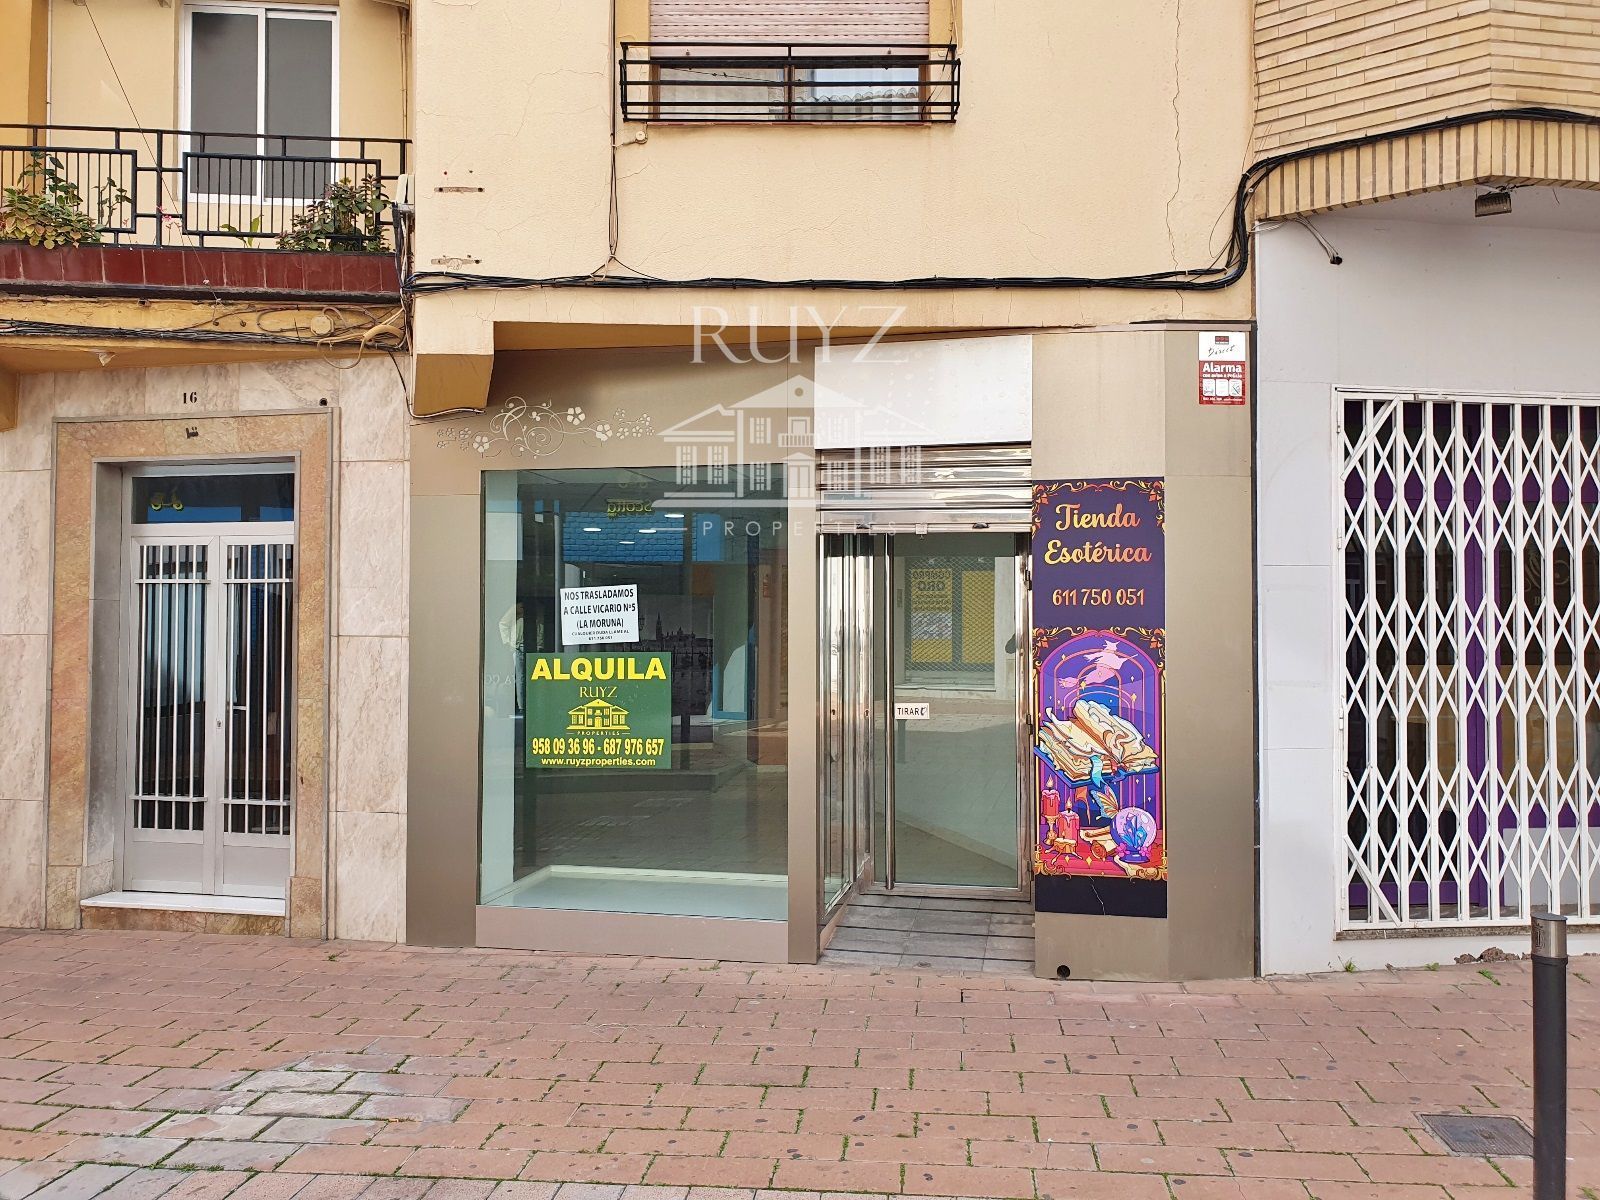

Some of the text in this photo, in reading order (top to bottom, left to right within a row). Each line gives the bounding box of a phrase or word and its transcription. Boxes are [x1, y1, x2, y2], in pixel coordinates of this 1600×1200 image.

[1203, 362, 1242, 372] Alarma
[183, 391, 197, 404] 16
[1055, 503, 1140, 531] Tienda
[1044, 539, 1152, 565] Esotérica
[564, 588, 634, 600] NOS TRASLADAMOS
[1052, 588, 1145, 606] 611 750 051
[563, 606, 569, 615] A
[570, 605, 592, 615] CALLE
[592, 603, 622, 614] VICARIO
[576, 617, 624, 630] (LA MORUNA)
[530, 657, 667, 682] ALQUILA
[579, 686, 617, 698] RUYZ
[897, 707, 919, 716] TIRAR
[532, 738, 551, 755] 958
[553, 738, 566, 755] 09
[567, 738, 580, 755] 36
[582, 738, 595, 755] 96
[603, 738, 622, 756] 687
[624, 738, 643, 756] 976
[645, 738, 665, 756] 657
[541, 757, 656, 767] www.ruyzproperties.com
